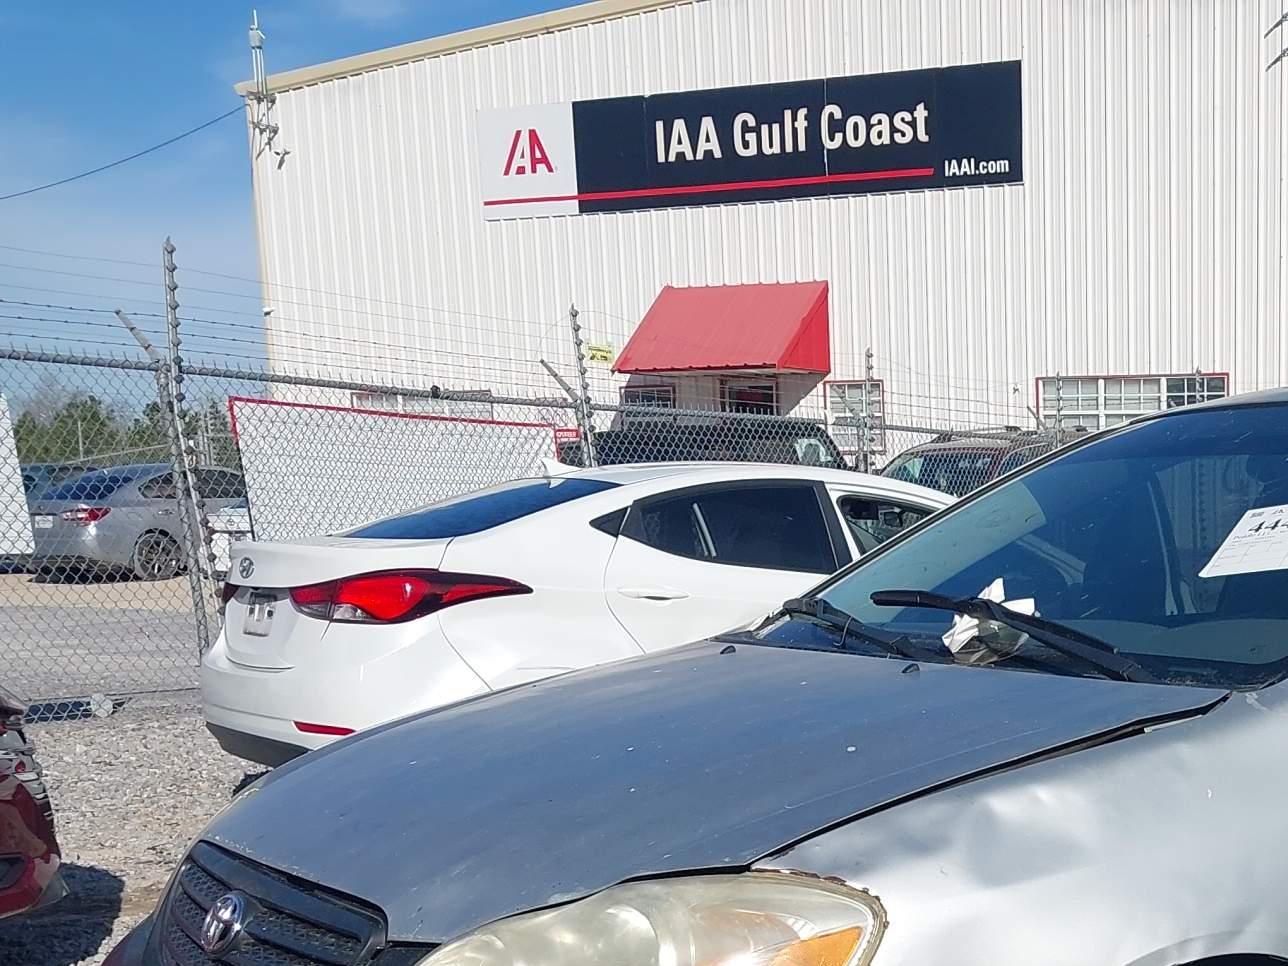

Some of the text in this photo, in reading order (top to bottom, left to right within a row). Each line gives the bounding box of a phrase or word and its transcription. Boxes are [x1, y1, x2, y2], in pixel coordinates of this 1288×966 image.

[655, 102, 930, 163] IAA Gulf Coast
